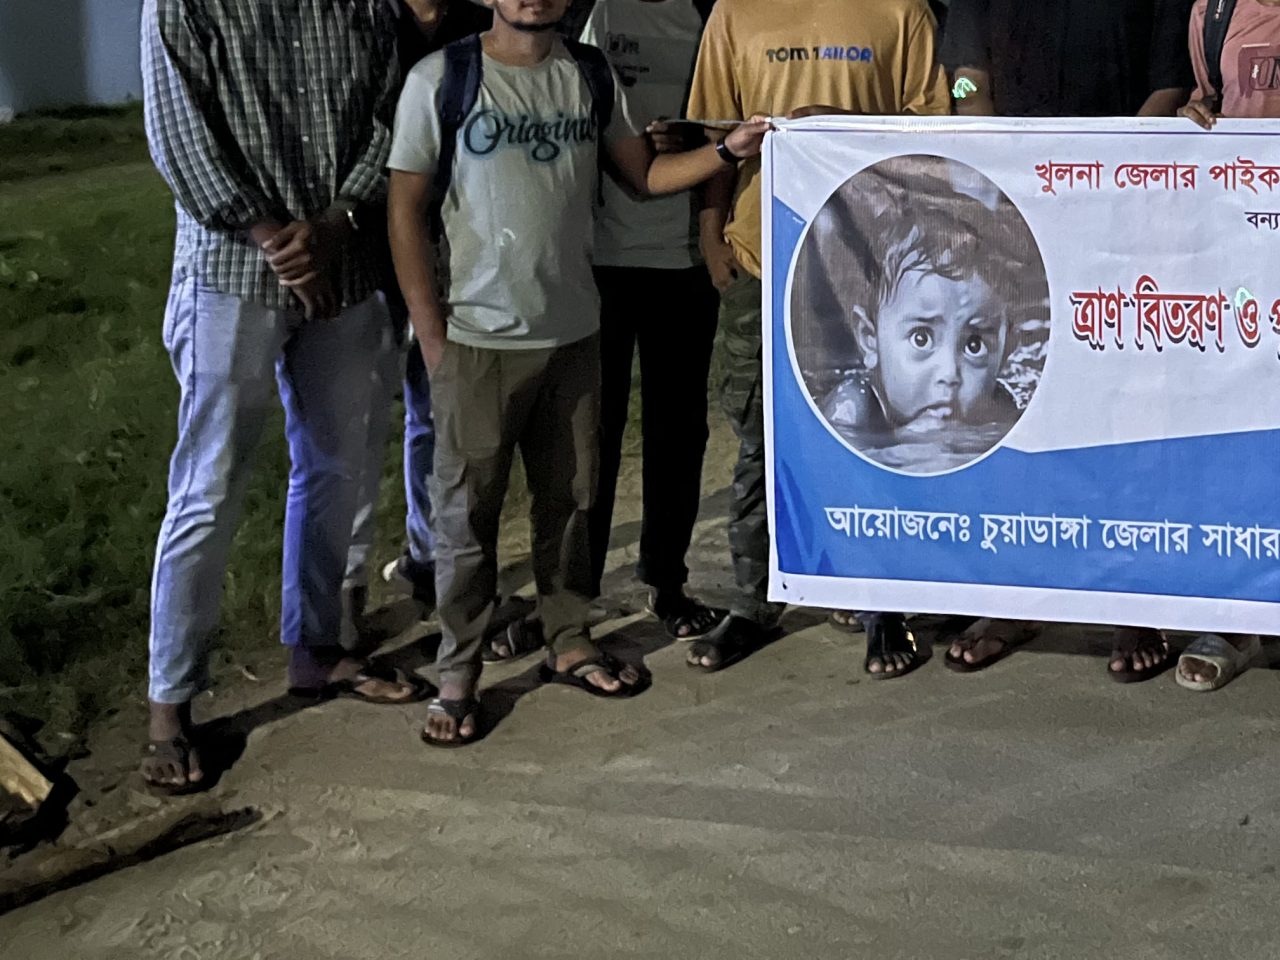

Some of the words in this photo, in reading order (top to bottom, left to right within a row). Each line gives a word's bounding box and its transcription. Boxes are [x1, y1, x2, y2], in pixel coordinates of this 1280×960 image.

[766, 46, 809, 63] TOM
[812, 46, 873, 63] TAILOR
[1035, 159, 1104, 196] খুলনা
[1113, 161, 1200, 194] জেলার
[1070, 285, 1127, 352] ত্রাণ
[1131, 274, 1227, 354] বিতরণ
[1233, 286, 1262, 349] ও
[824, 503, 971, 543] আয়োজনেঃ
[979, 512, 1093, 554] চুয়াডাঙ্গা
[1099, 515, 1193, 555] জেলার
